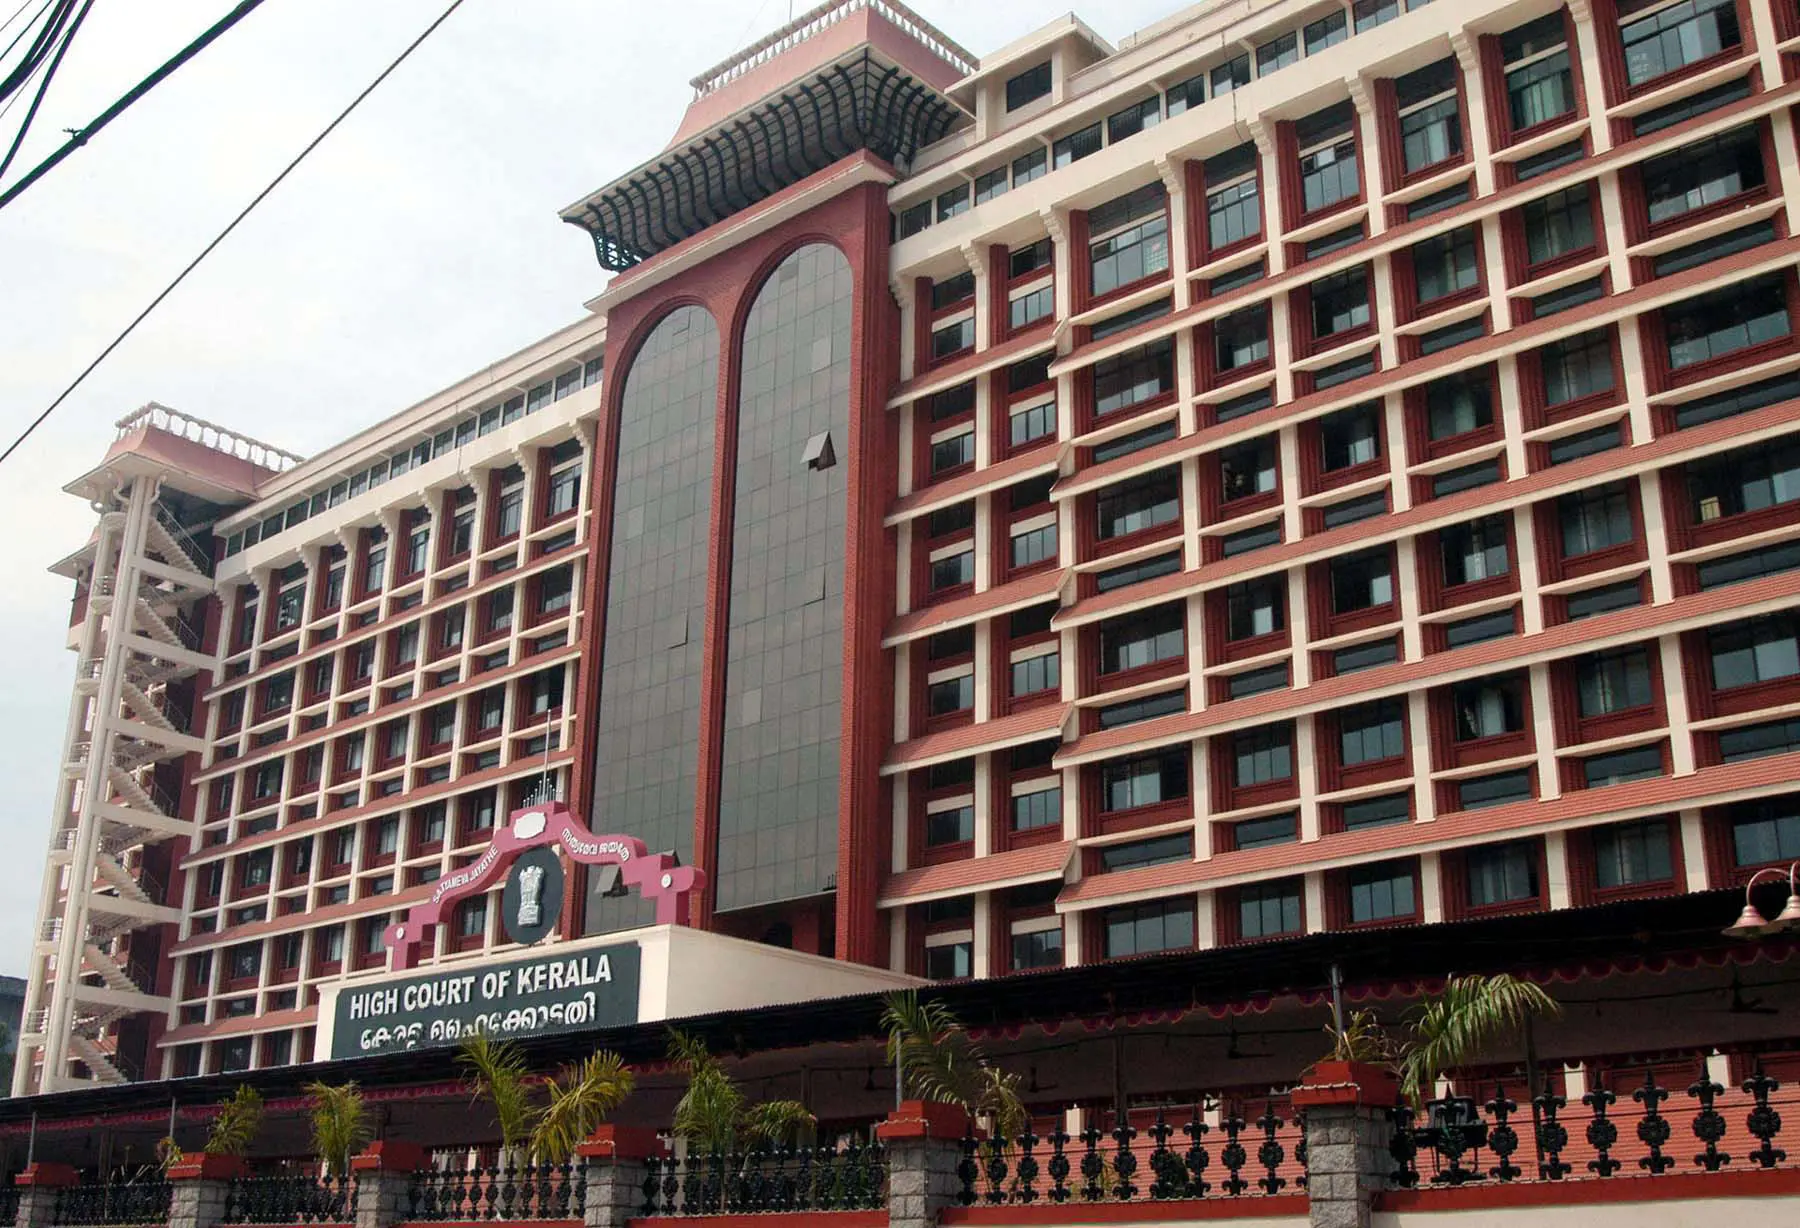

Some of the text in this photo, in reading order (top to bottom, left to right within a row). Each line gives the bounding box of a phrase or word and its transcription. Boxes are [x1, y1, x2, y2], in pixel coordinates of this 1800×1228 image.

[350, 954, 612, 1020] HIGH COURT OF KERALA
